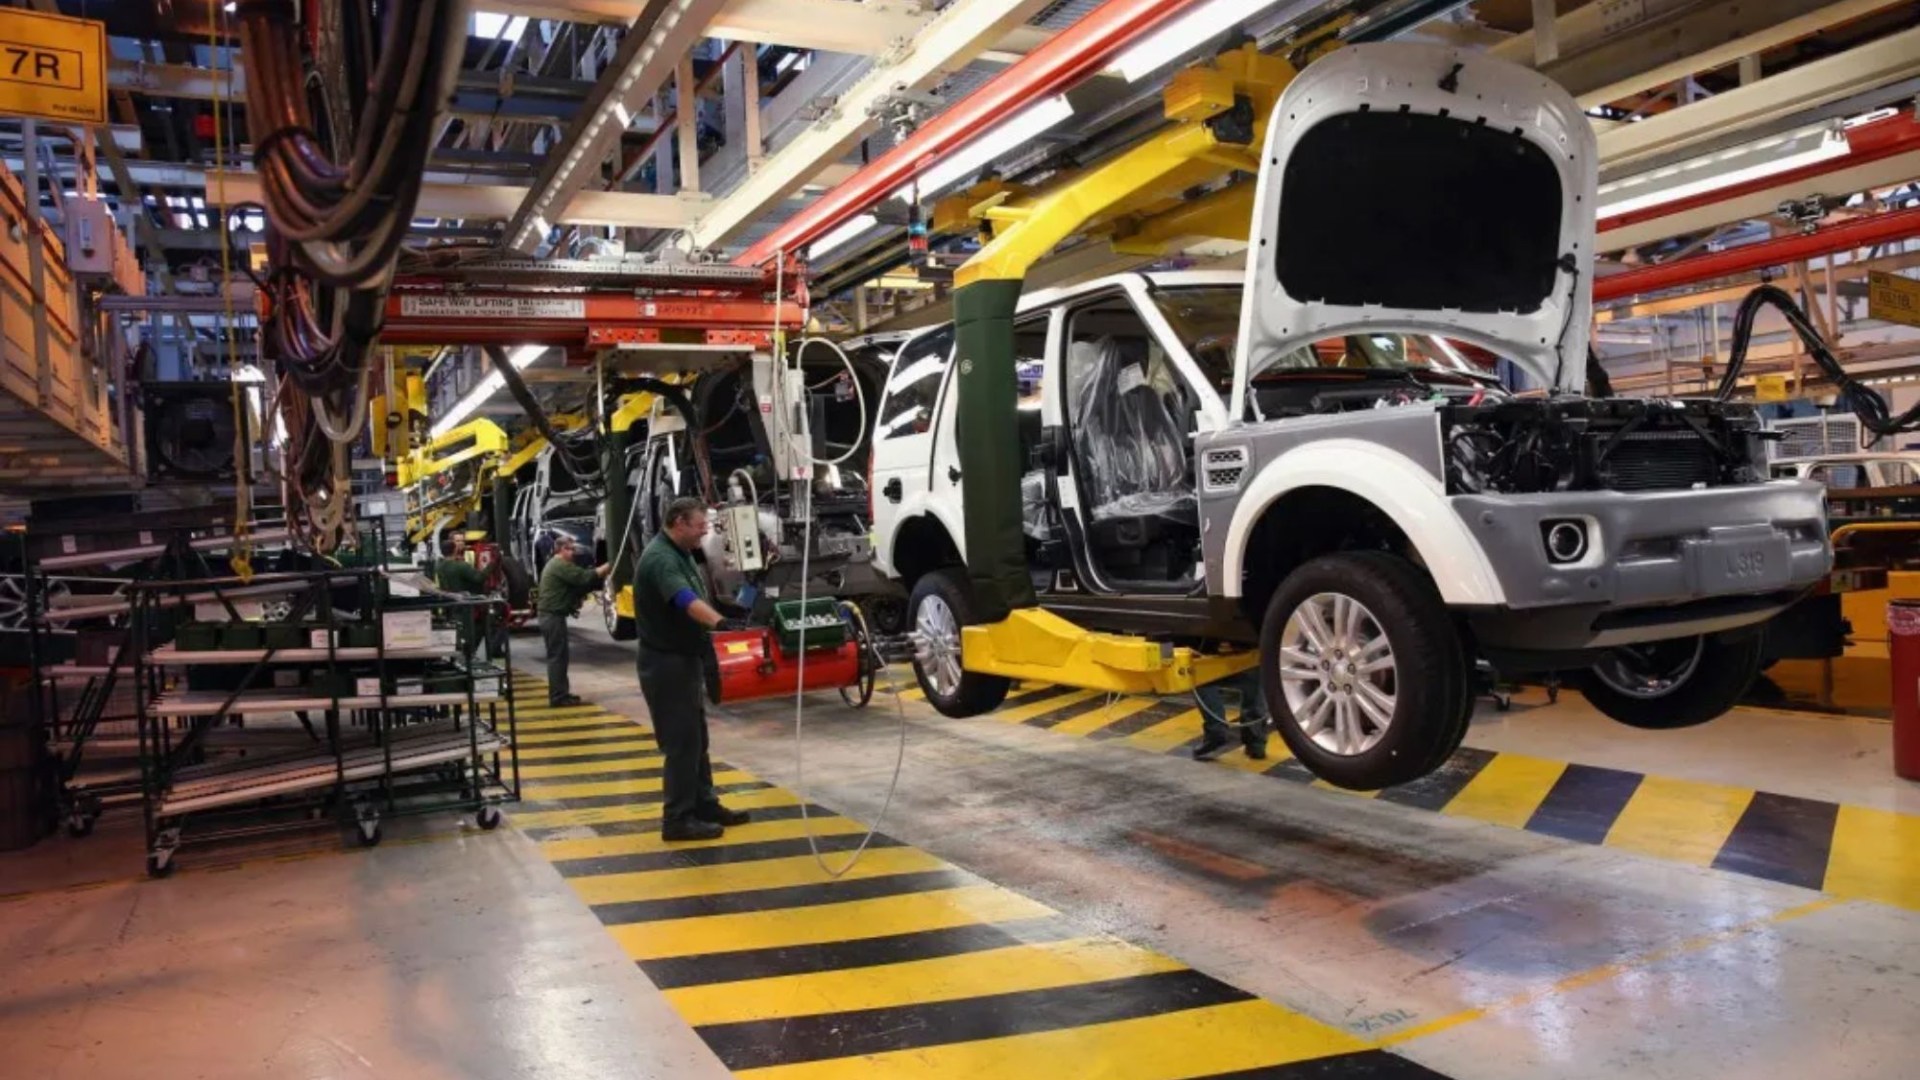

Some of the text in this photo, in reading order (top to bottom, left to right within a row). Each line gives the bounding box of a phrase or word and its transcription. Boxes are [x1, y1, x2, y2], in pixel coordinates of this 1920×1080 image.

[5, 47, 60, 80] 7R
[418, 296, 446, 306] SAFE
[449, 296, 471, 306] WAY
[474, 297, 513, 307] LIFTING
